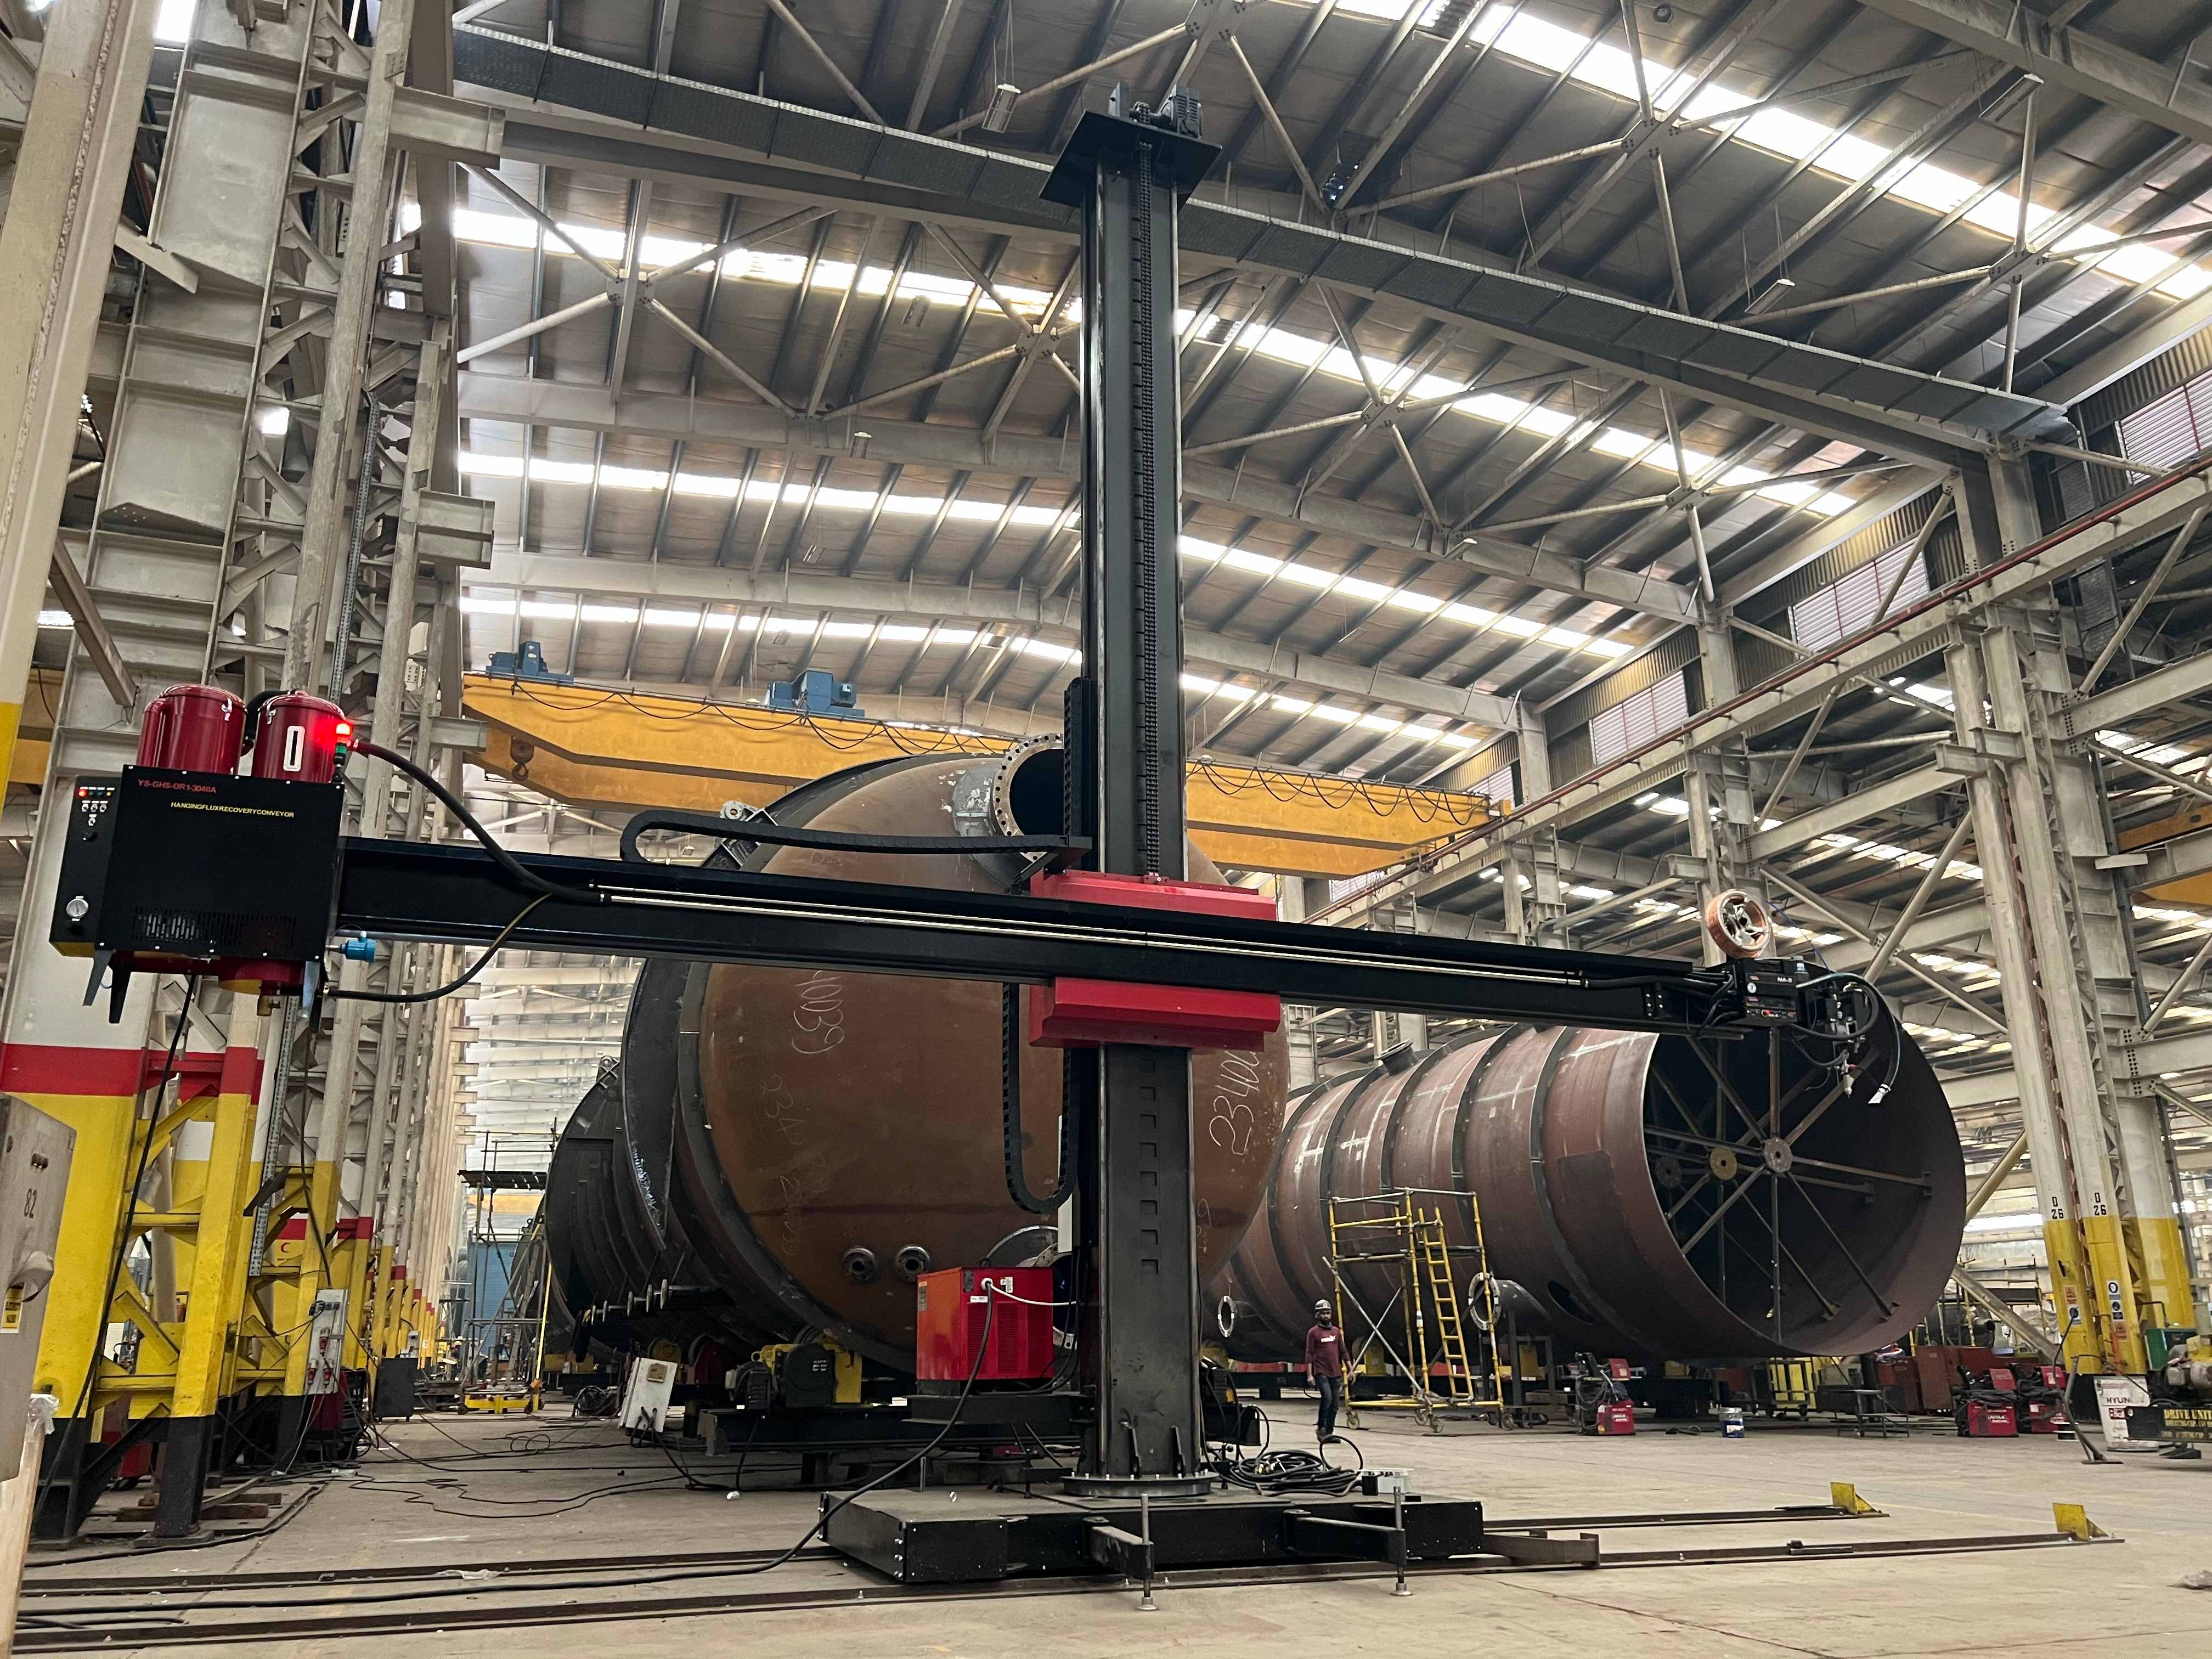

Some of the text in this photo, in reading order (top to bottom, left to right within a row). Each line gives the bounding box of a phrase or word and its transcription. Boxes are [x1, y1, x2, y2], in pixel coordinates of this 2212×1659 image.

[24, 1188, 37, 1218] 82
[2051, 1209, 2064, 1220] 26
[2094, 1204, 2107, 1216] 26
